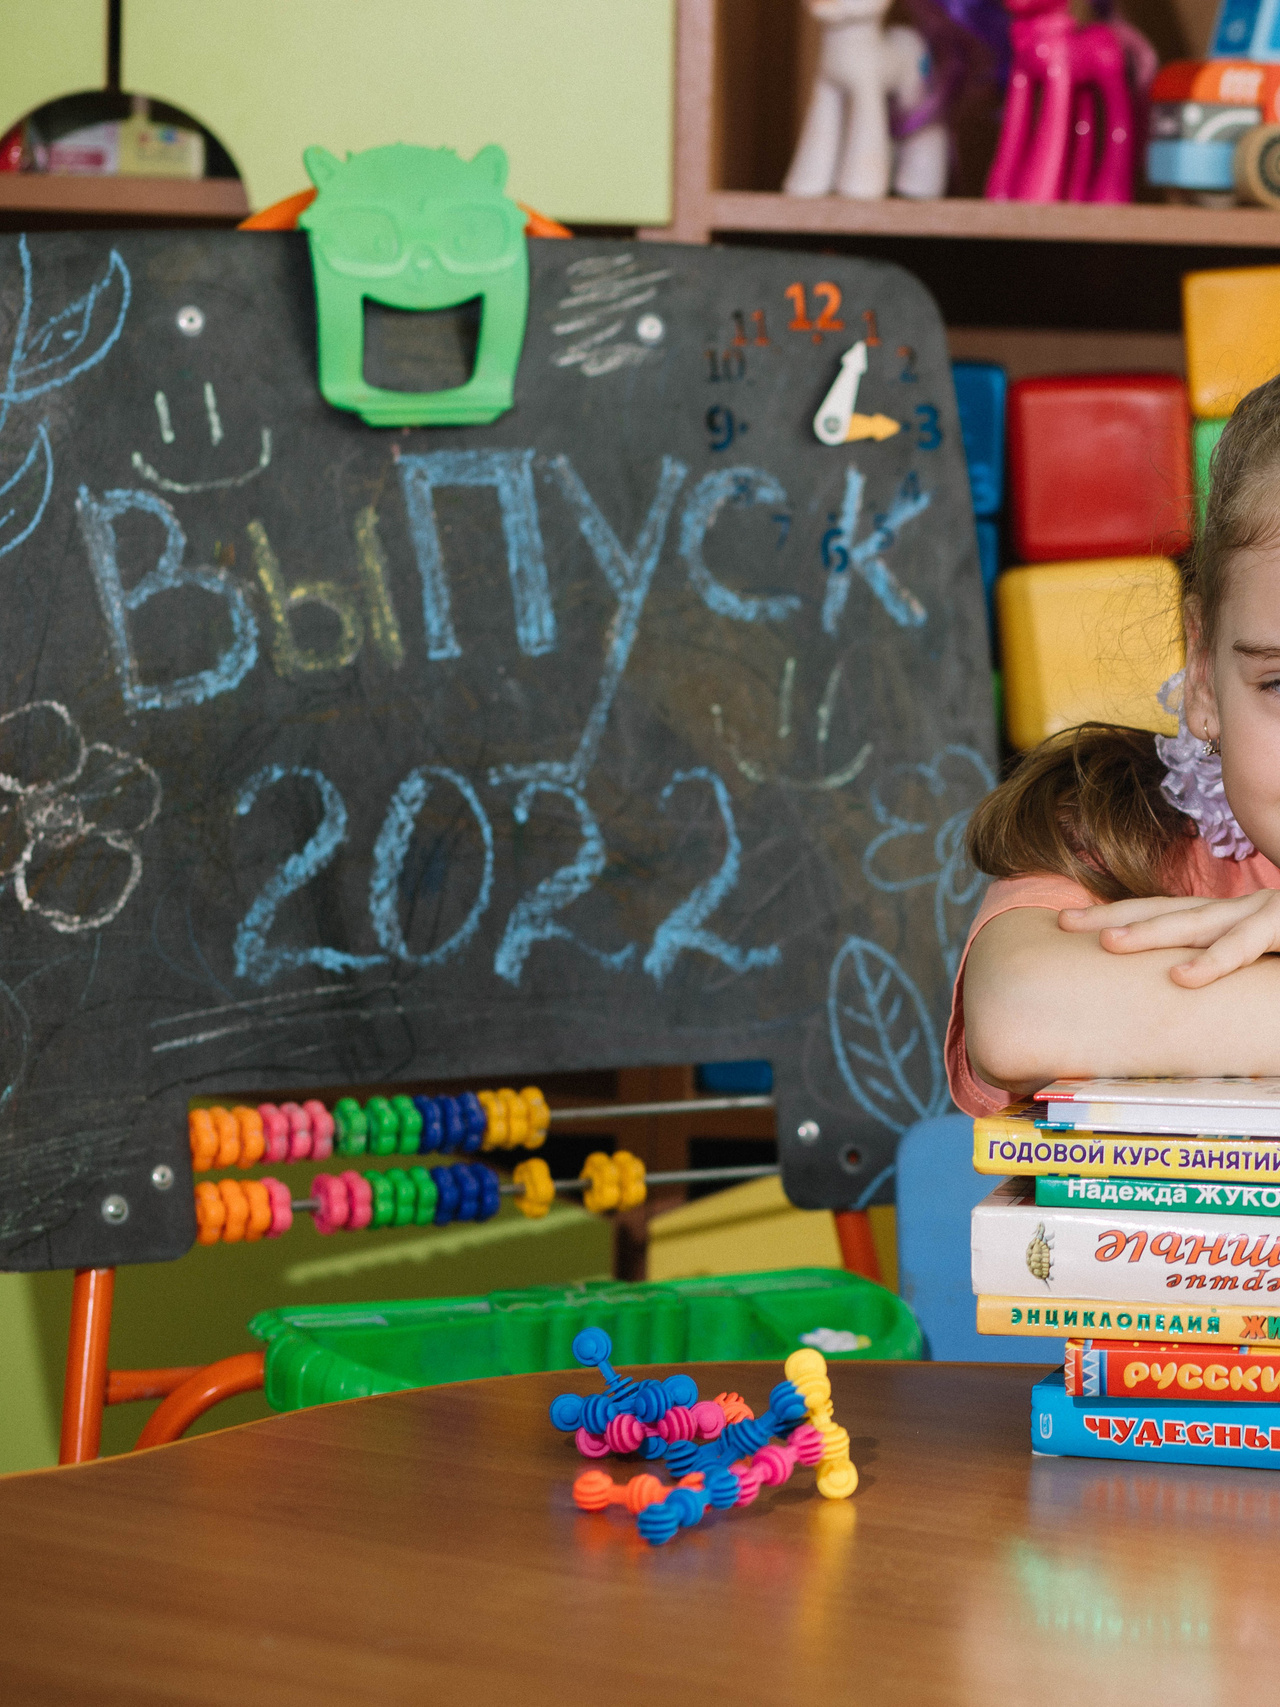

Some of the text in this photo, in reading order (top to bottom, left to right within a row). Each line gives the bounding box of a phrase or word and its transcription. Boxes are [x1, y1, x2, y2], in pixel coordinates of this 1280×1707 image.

[785, 281, 846, 331] 12
[706, 404, 734, 451] 9
[914, 403, 943, 450] 3
[820, 527, 849, 573] 6
[234, 765, 783, 986] 2022
[987, 1137, 1106, 1164] ГОДОВОЙ
[1113, 1145, 1171, 1167] КУРС
[1067, 1178, 1188, 1206] Надежда
[1010, 1307, 1220, 1336] ЭНЦИКЛОПЕДИЯ
